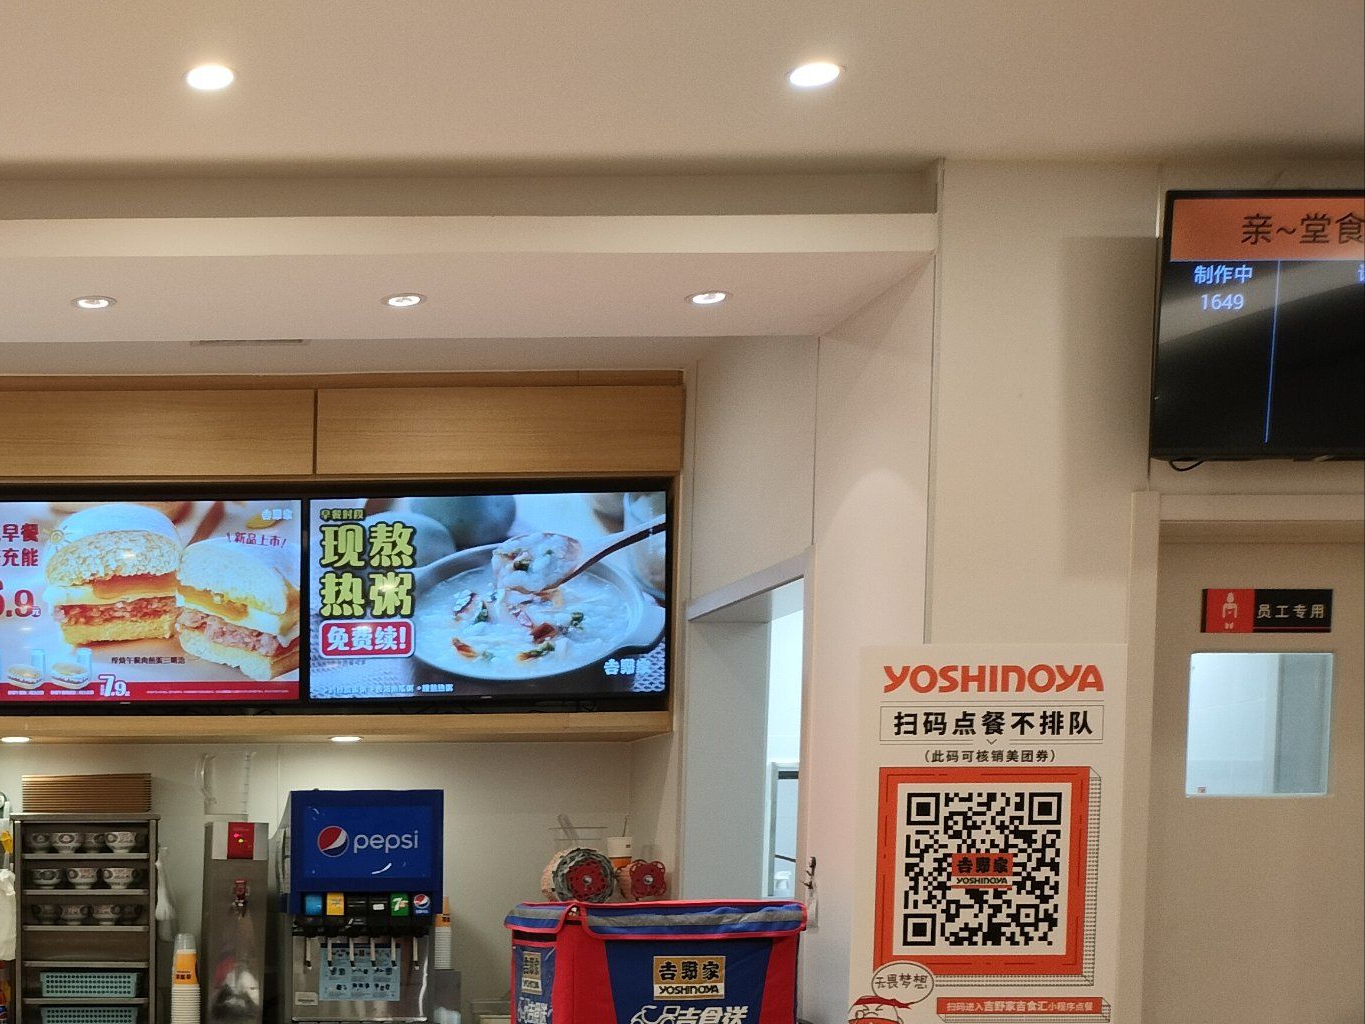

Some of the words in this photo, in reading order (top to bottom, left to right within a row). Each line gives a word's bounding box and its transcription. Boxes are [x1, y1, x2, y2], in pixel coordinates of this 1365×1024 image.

[1194, 264, 1253, 285] 制作中
[1200, 294, 1245, 311] 1649
[320, 509, 364, 519] 早餐时段
[234, 532, 282, 547] 新品上市
[321, 522, 414, 568] 现熬
[321, 571, 412, 617] 热粥
[1257, 603, 1325, 619] 员工专用
[327, 626, 407, 651] 免费续!
[883, 664, 1105, 694] YOSHINOYA
[893, 711, 1093, 736] 扫码点餐不排队
[353, 830, 419, 853] pepsi
[658, 985, 720, 996] YOSHINOYA
[875, 973, 928, 989] 无畏梦想
